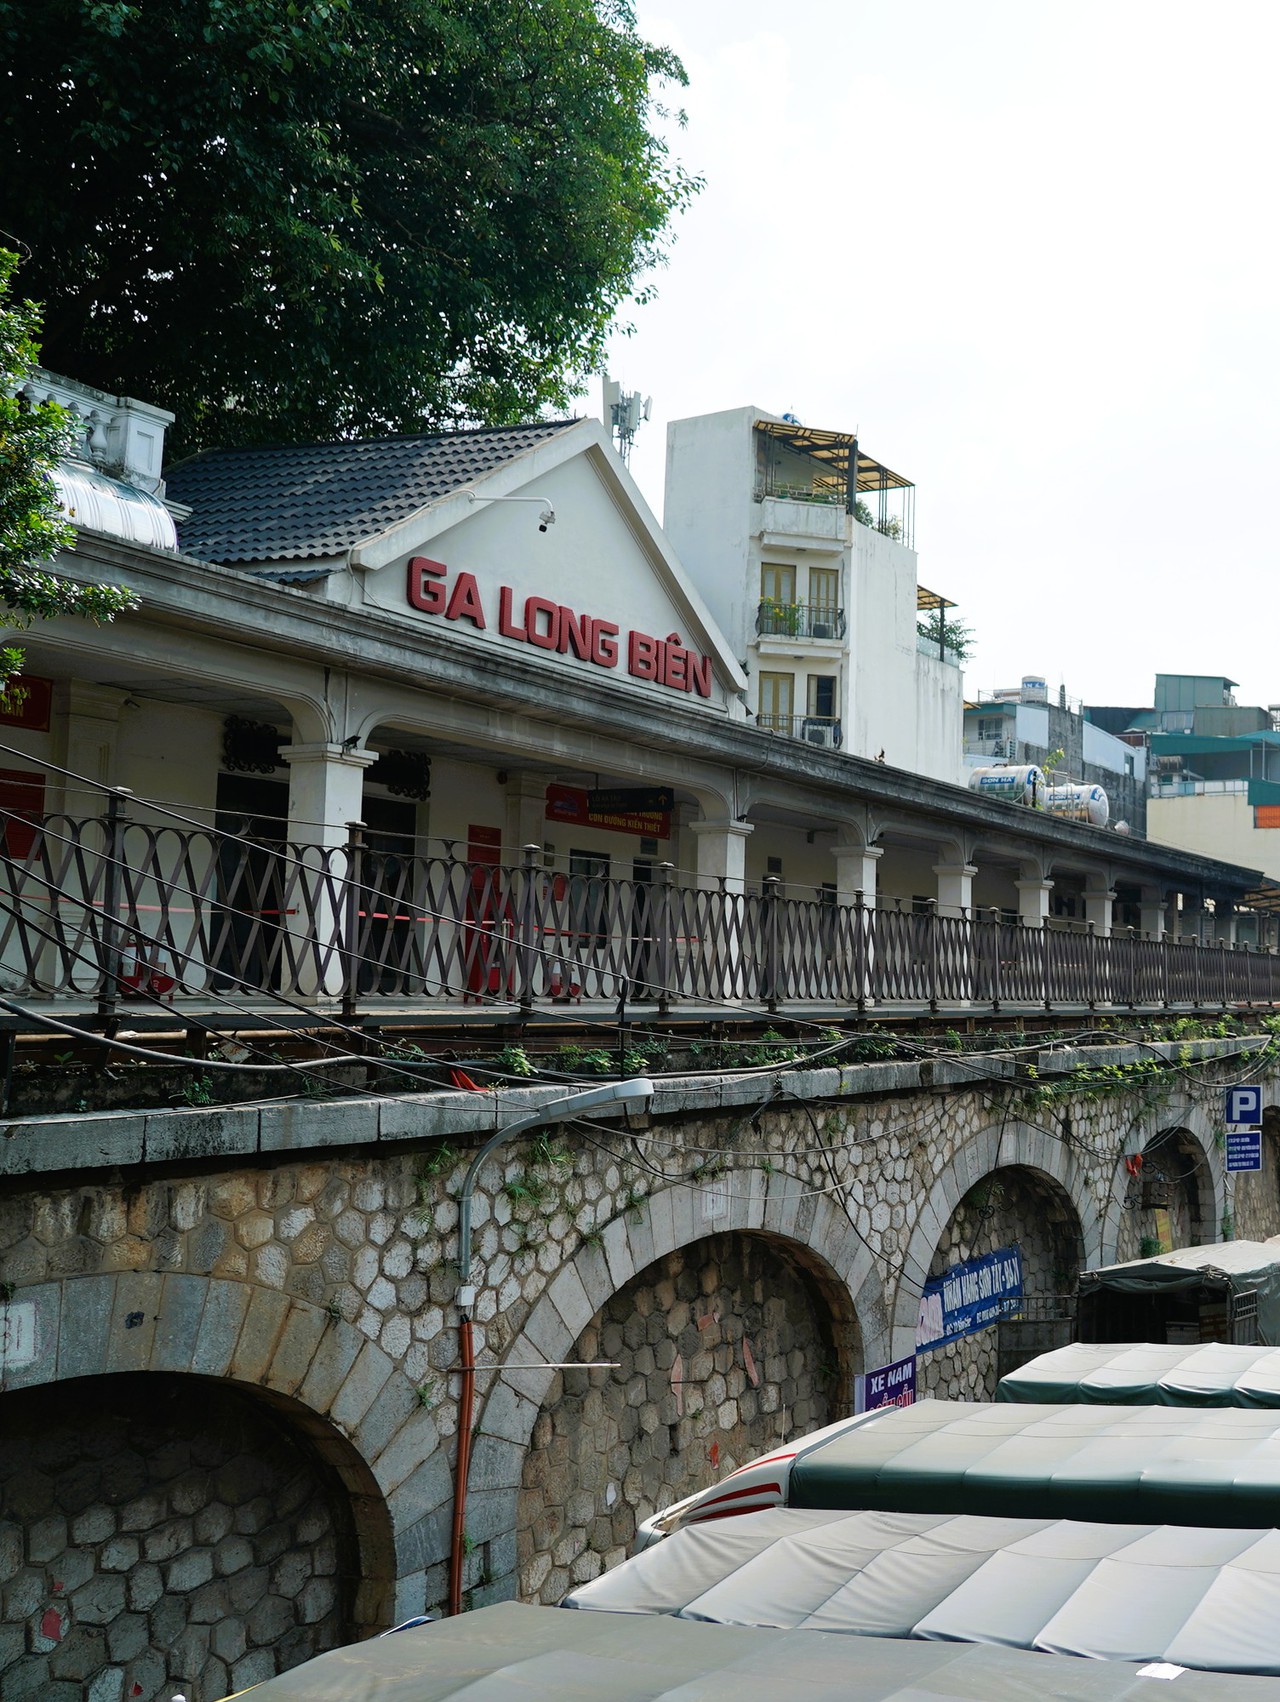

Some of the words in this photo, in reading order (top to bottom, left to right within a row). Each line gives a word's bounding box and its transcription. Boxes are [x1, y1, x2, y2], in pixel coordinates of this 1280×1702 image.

[407, 556, 486, 630] GA
[500, 586, 619, 668] LONG
[628, 631, 712, 698] BIÊN
[1232, 1091, 1257, 1120] P
[871, 1374, 885, 1395] XE
[887, 1362, 912, 1387] NAM
